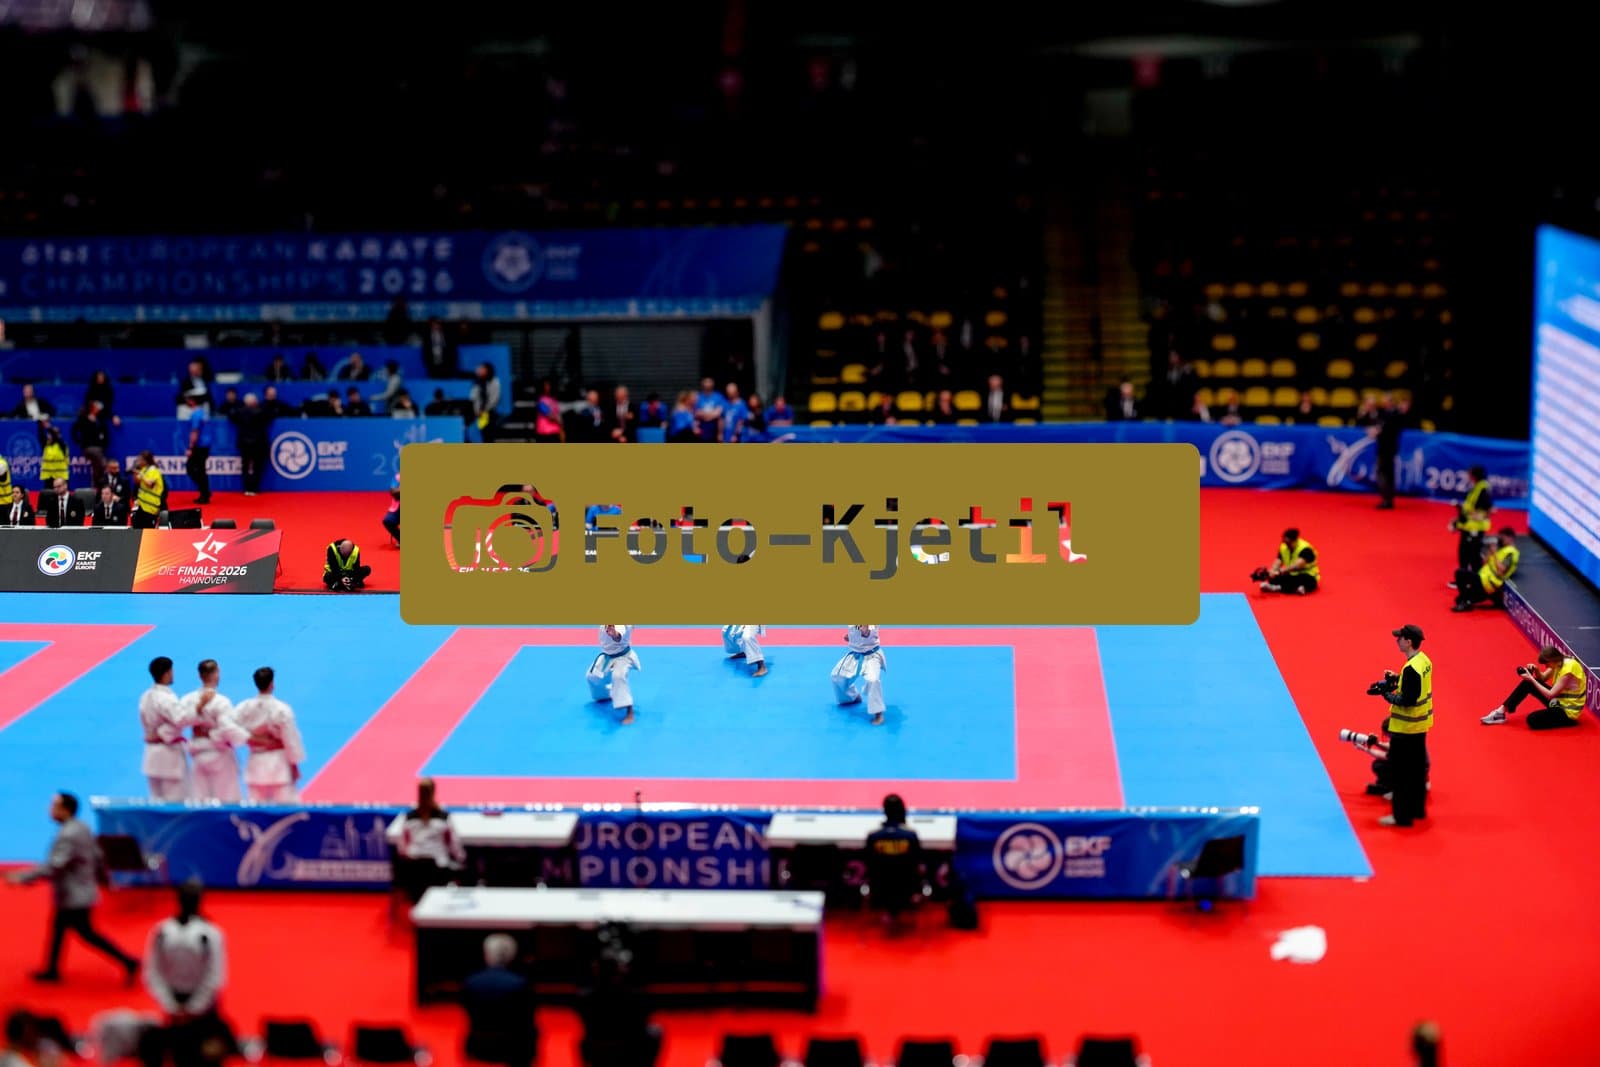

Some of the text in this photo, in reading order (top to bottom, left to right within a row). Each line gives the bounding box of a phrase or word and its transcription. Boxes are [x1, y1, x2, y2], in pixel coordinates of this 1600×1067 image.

[307, 236, 453, 263] KARATE
[357, 266, 455, 295] 2026
[1425, 466, 1471, 493] 202
[77, 551, 102, 561] EKF
[158, 566, 248, 576] DIE FINALS 2026
[178, 576, 228, 585] HANNOVER
[575, 821, 768, 851] UROPEAN
[1064, 835, 1112, 856] EKF
